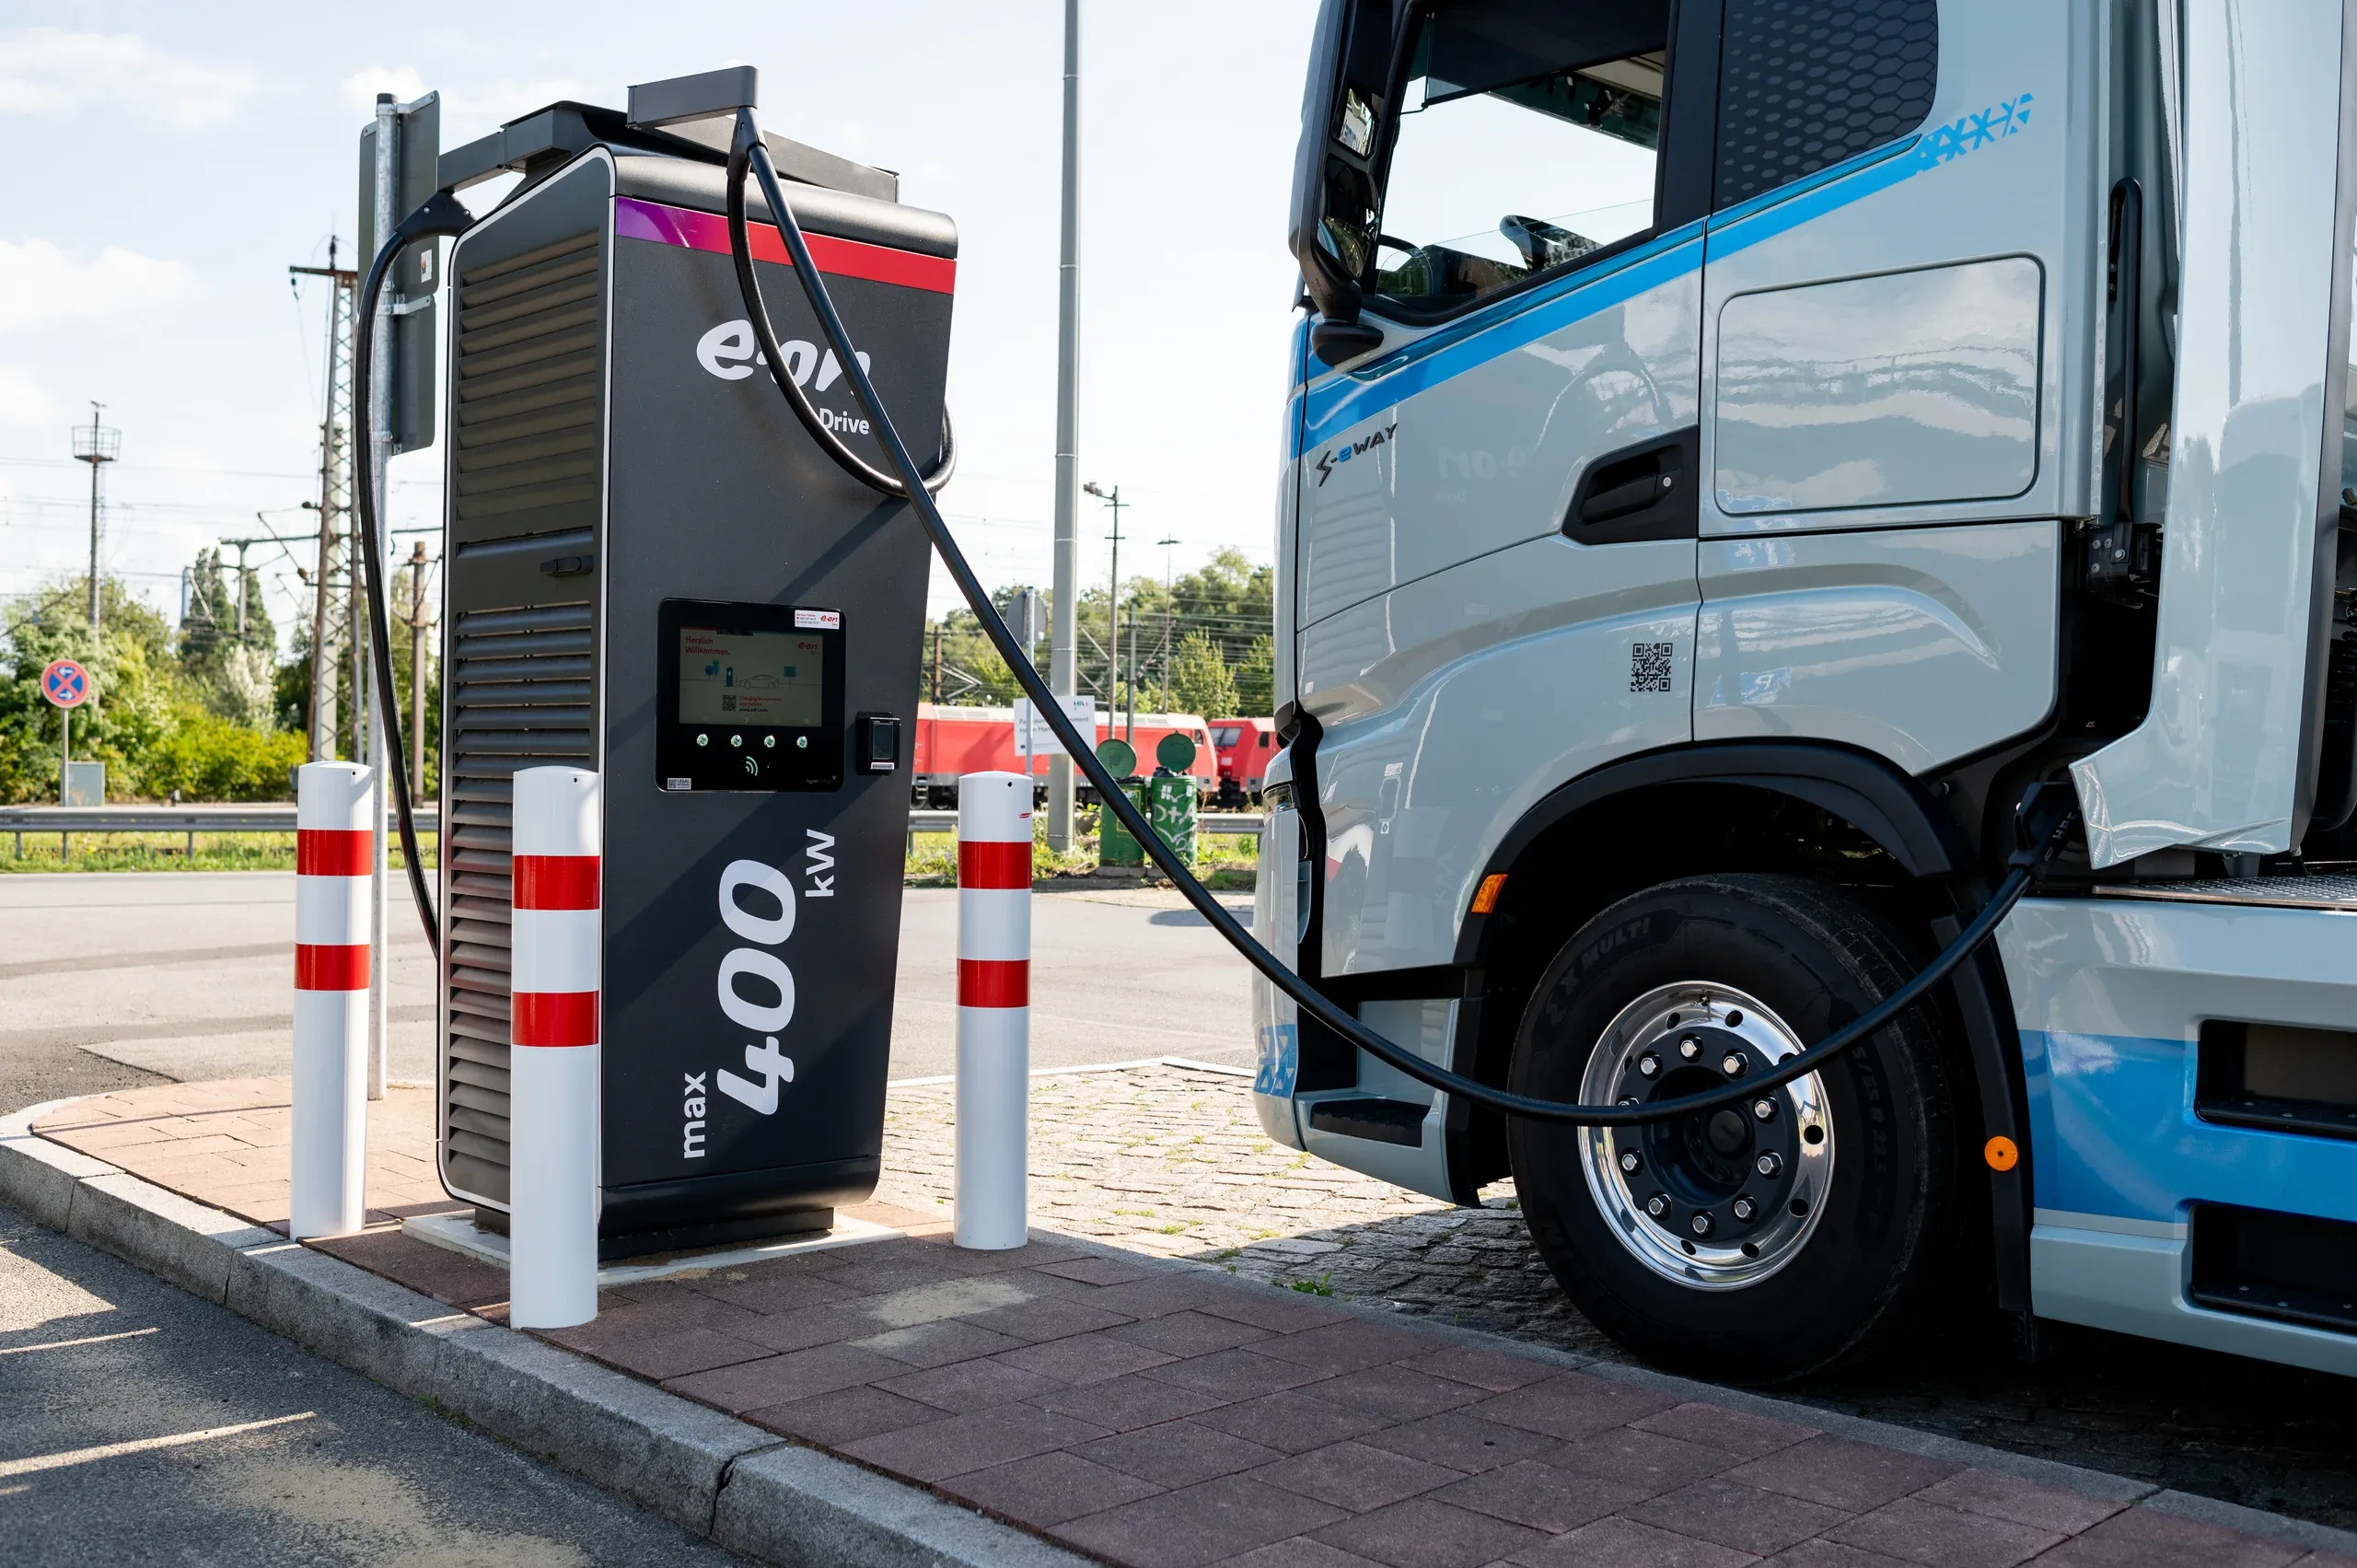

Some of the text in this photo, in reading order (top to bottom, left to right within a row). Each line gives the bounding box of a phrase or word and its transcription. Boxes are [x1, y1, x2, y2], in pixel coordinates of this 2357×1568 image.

[819, 408, 870, 435] Drive
[685, 646, 731, 656] Willkommen.
[805, 829, 835, 897] kW
[1581, 917, 1651, 970] MULTI
[717, 859, 796, 1115] 400
[683, 1071, 706, 1159] max
